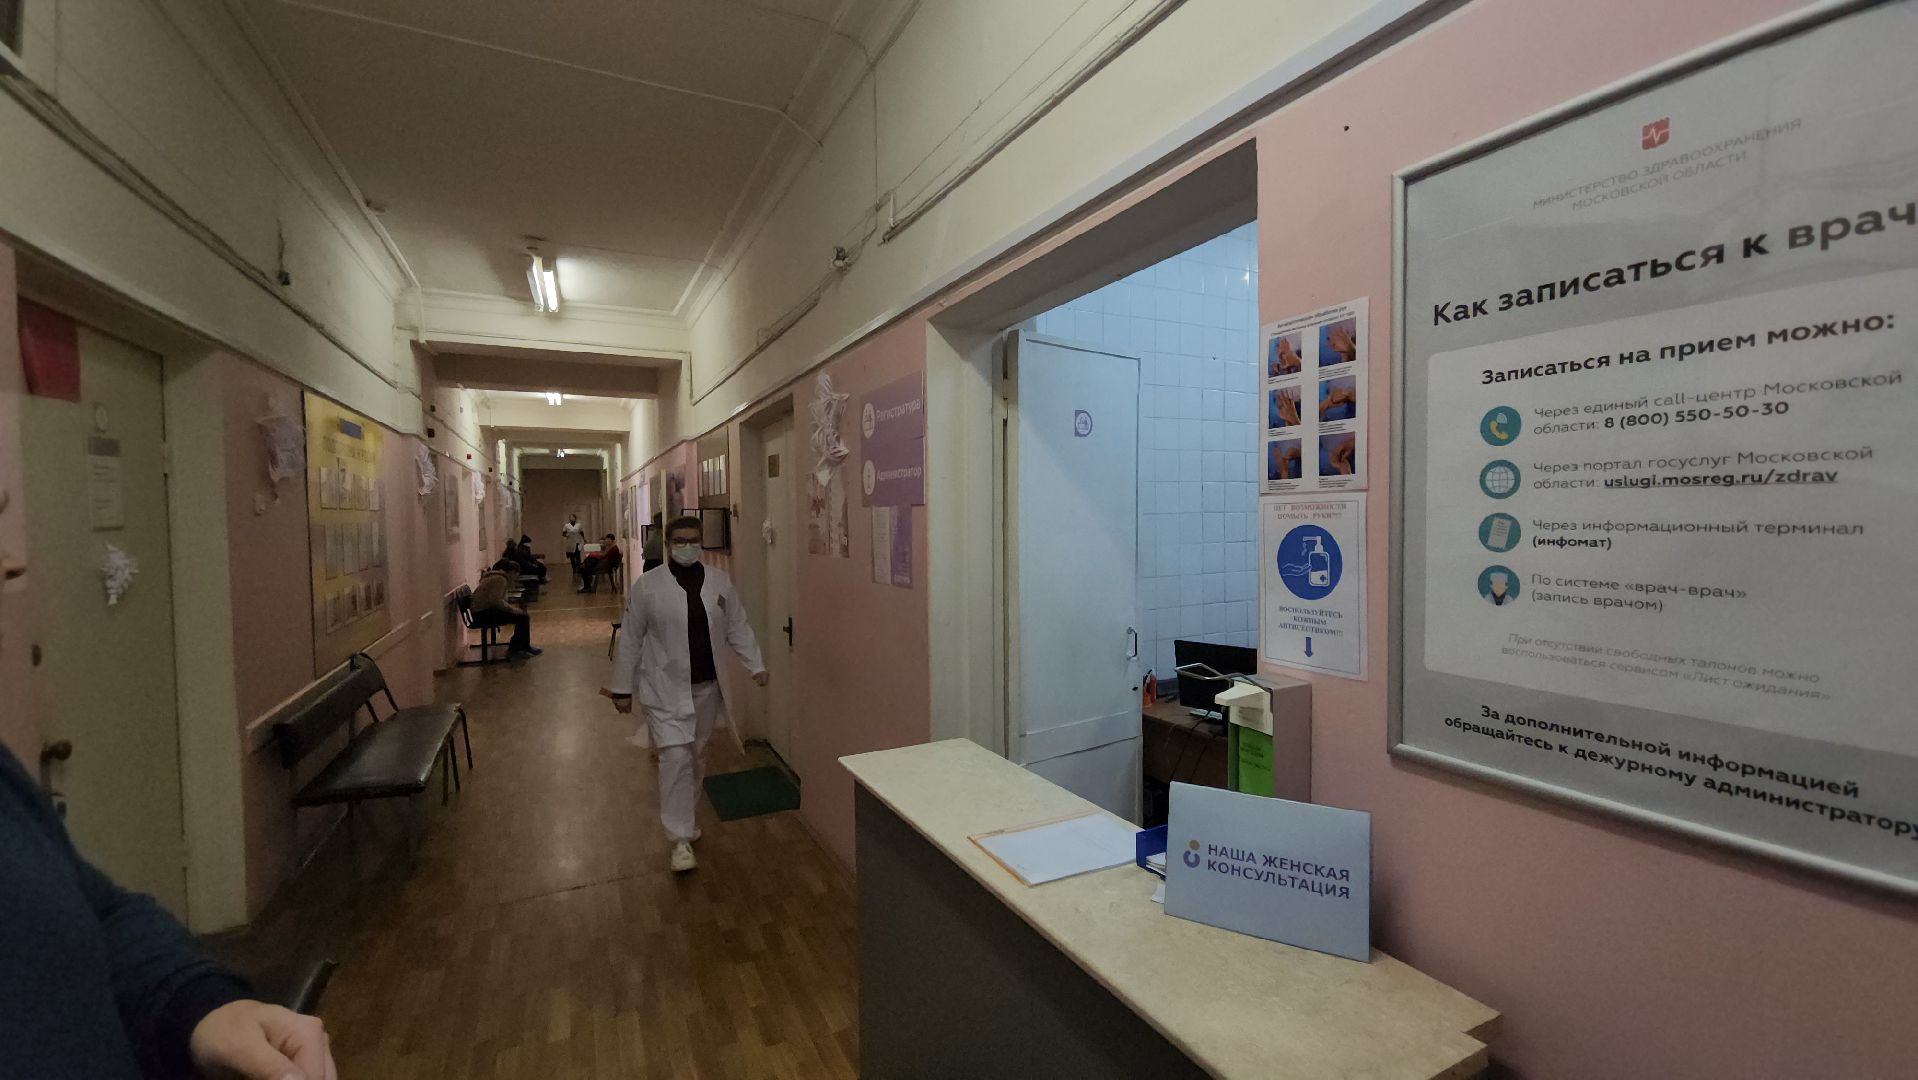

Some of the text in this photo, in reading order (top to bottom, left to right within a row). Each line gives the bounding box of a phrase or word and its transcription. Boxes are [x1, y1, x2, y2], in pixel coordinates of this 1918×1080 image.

[1533, 118, 1802, 208] МИНИСТЕРСТВО ЗДРАВООХРАНЕНИЯ
[1572, 152, 1747, 211] МОСКОВСКОЙ ОБЛАСТИ
[1433, 202, 1917, 326] Как записаться к врач
[1481, 314, 1895, 385] Записаться на прием можно:
[876, 399, 920, 421] Регистратура
[1534, 370, 1903, 419] Через единый call-центр Московской
[1534, 401, 1790, 435] области: 8 (800) 550-50-30
[876, 466, 921, 481] Администратор
[1533, 446, 1874, 474] Через портал госуслуг Московской
[1534, 469, 1838, 490] области: uslugi.mosreg.ru/zdrav
[1273, 503, 1347, 512] НЕТ ВОЗМОЖНОСТИ
[1532, 536, 1612, 551] (инфомат)
[1533, 519, 1864, 536] Через информационный терминал
[1531, 574, 1747, 599] По системе «врач-врач»
[1531, 589, 1663, 613] (запись врачом)
[1502, 647, 1606, 669] воспользоваться
[1609, 662, 1679, 679] сервисом
[1732, 679, 1831, 700] ожидания»
[1508, 633, 1820, 684] При отсутствии свободных талонов можно
[1444, 716, 1553, 751] обращайтесь
[1558, 743, 1569, 754] к
[1574, 747, 1697, 787] дежурному
[1481, 705, 1860, 798] За дополнительной информацией
[1207, 859, 1350, 899] КОНСУЛЬТАЦИЯ
[1208, 843, 1350, 882] НАША ЖЕНСКАЯ
